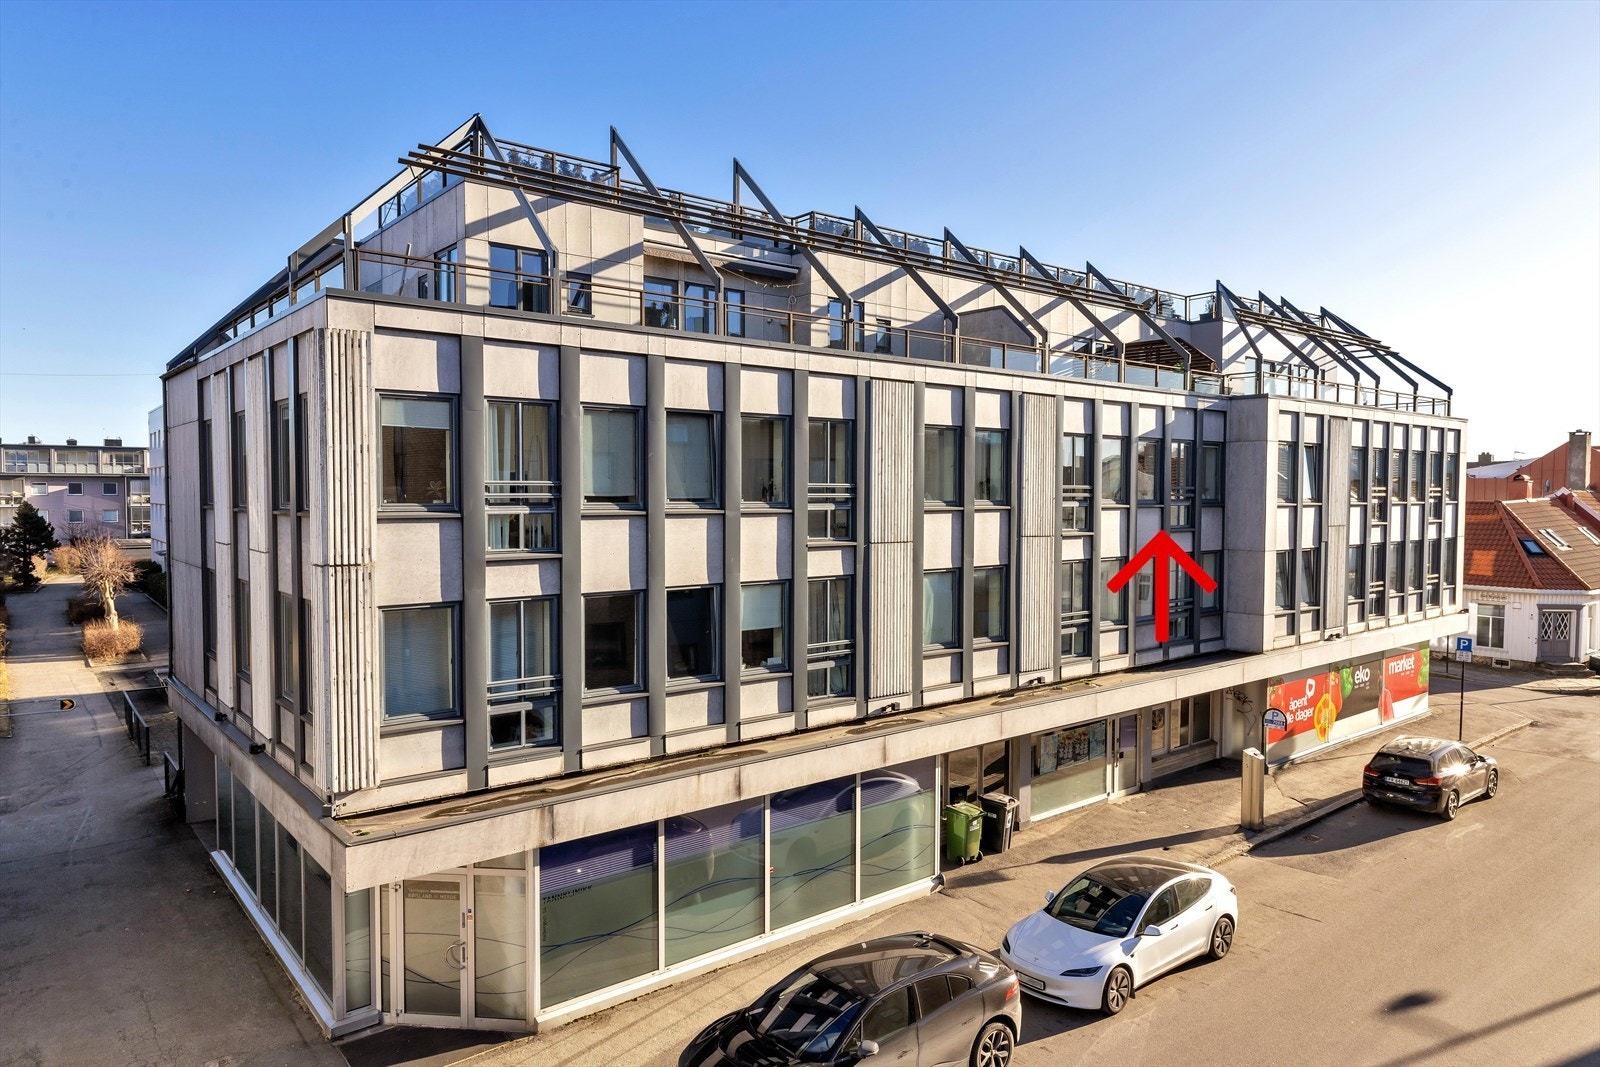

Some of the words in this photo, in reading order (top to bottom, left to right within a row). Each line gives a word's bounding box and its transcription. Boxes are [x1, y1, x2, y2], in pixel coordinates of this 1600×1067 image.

[1460, 639, 1469, 650] P
[1388, 654, 1415, 675] market
[1354, 665, 1371, 684] eko
[1289, 694, 1308, 712] åpent
[1271, 711, 1279, 720] P
[1295, 707, 1315, 722] dager
[542, 885, 593, 904] TANNKLINIKK
